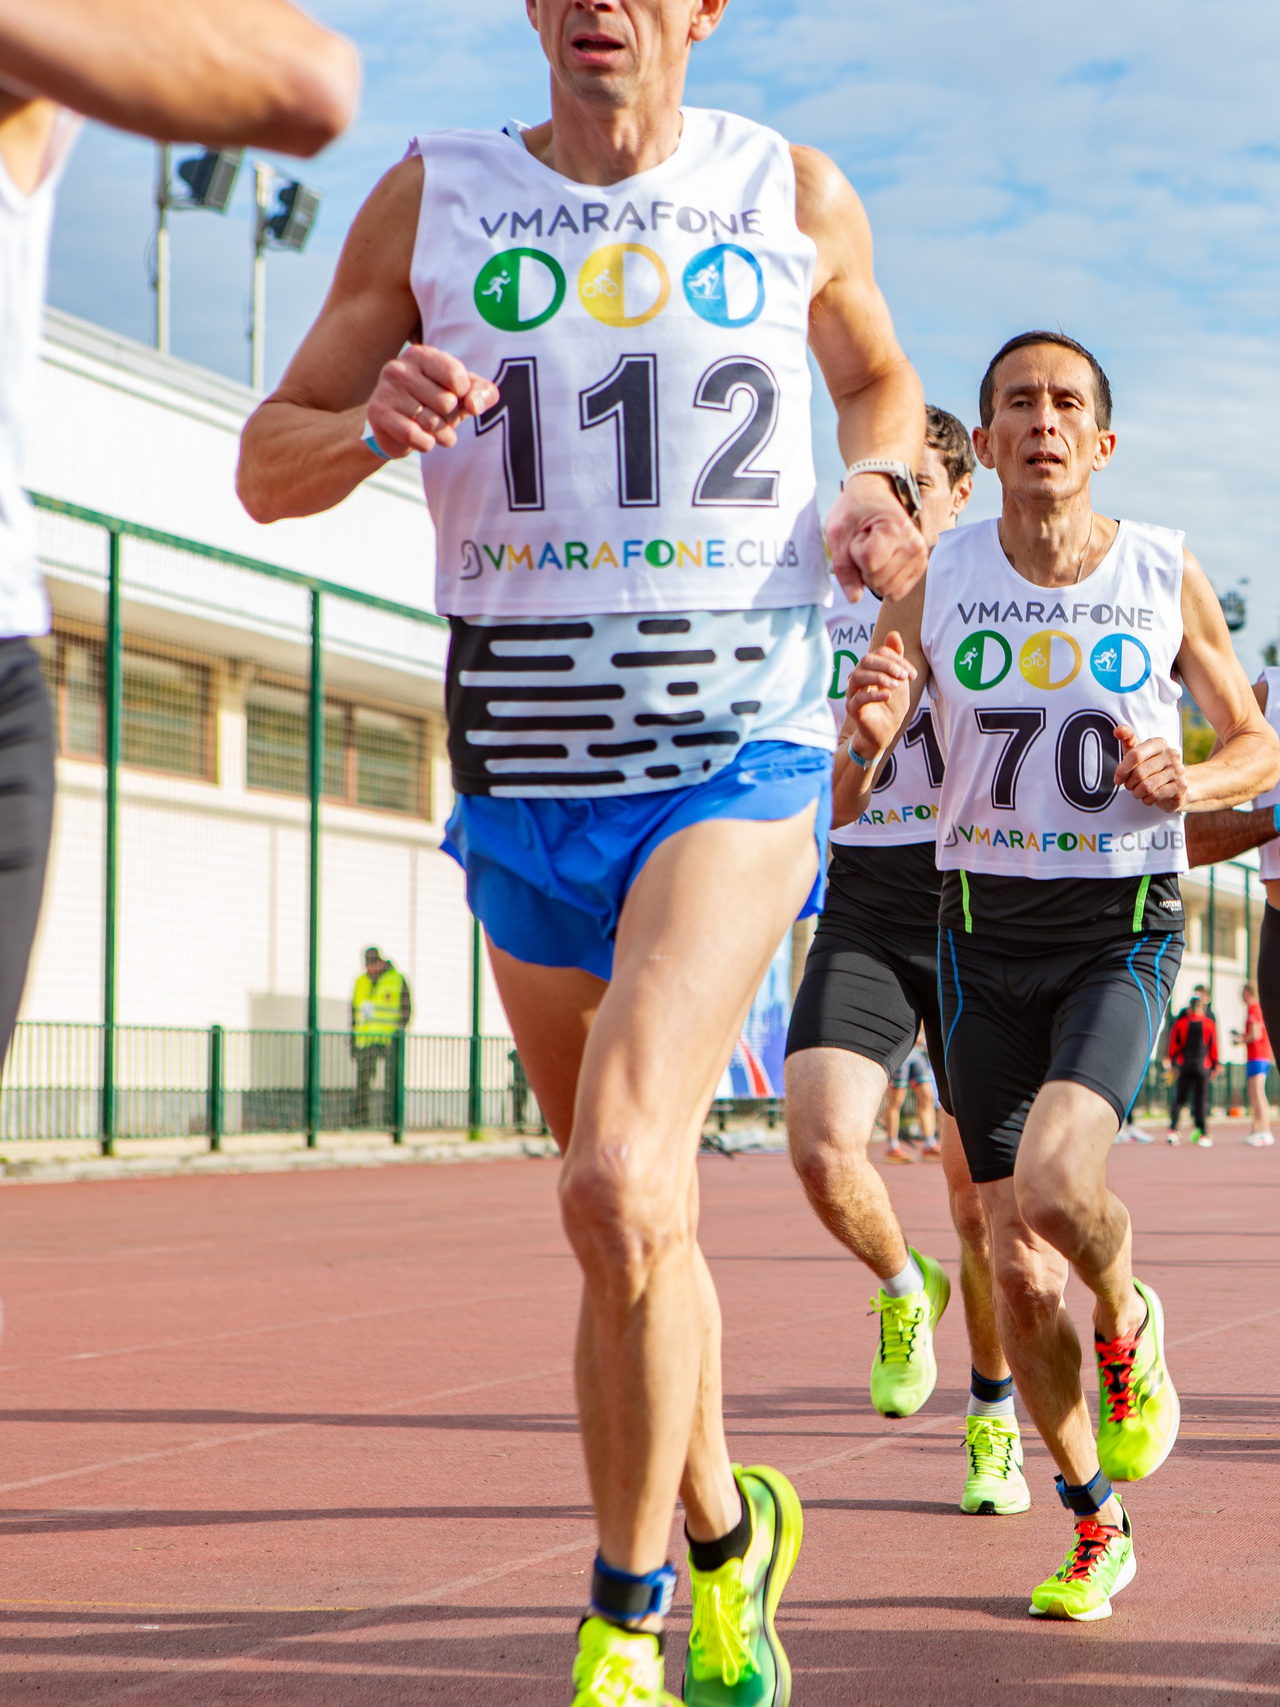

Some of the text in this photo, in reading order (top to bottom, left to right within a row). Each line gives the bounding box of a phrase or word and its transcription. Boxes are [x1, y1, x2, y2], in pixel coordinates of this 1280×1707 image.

[479, 201, 765, 238] VMARAFONE
[475, 353, 781, 512] 112
[483, 539, 799, 572] VMARAFONE.CLUB
[957, 600, 1154, 631] VMARAFONE
[871, 707, 945, 794] 1
[974, 707, 1123, 814] 70
[854, 803, 939, 826] ARAFO
[958, 824, 1185, 853] VMARAFONE.CLUB
